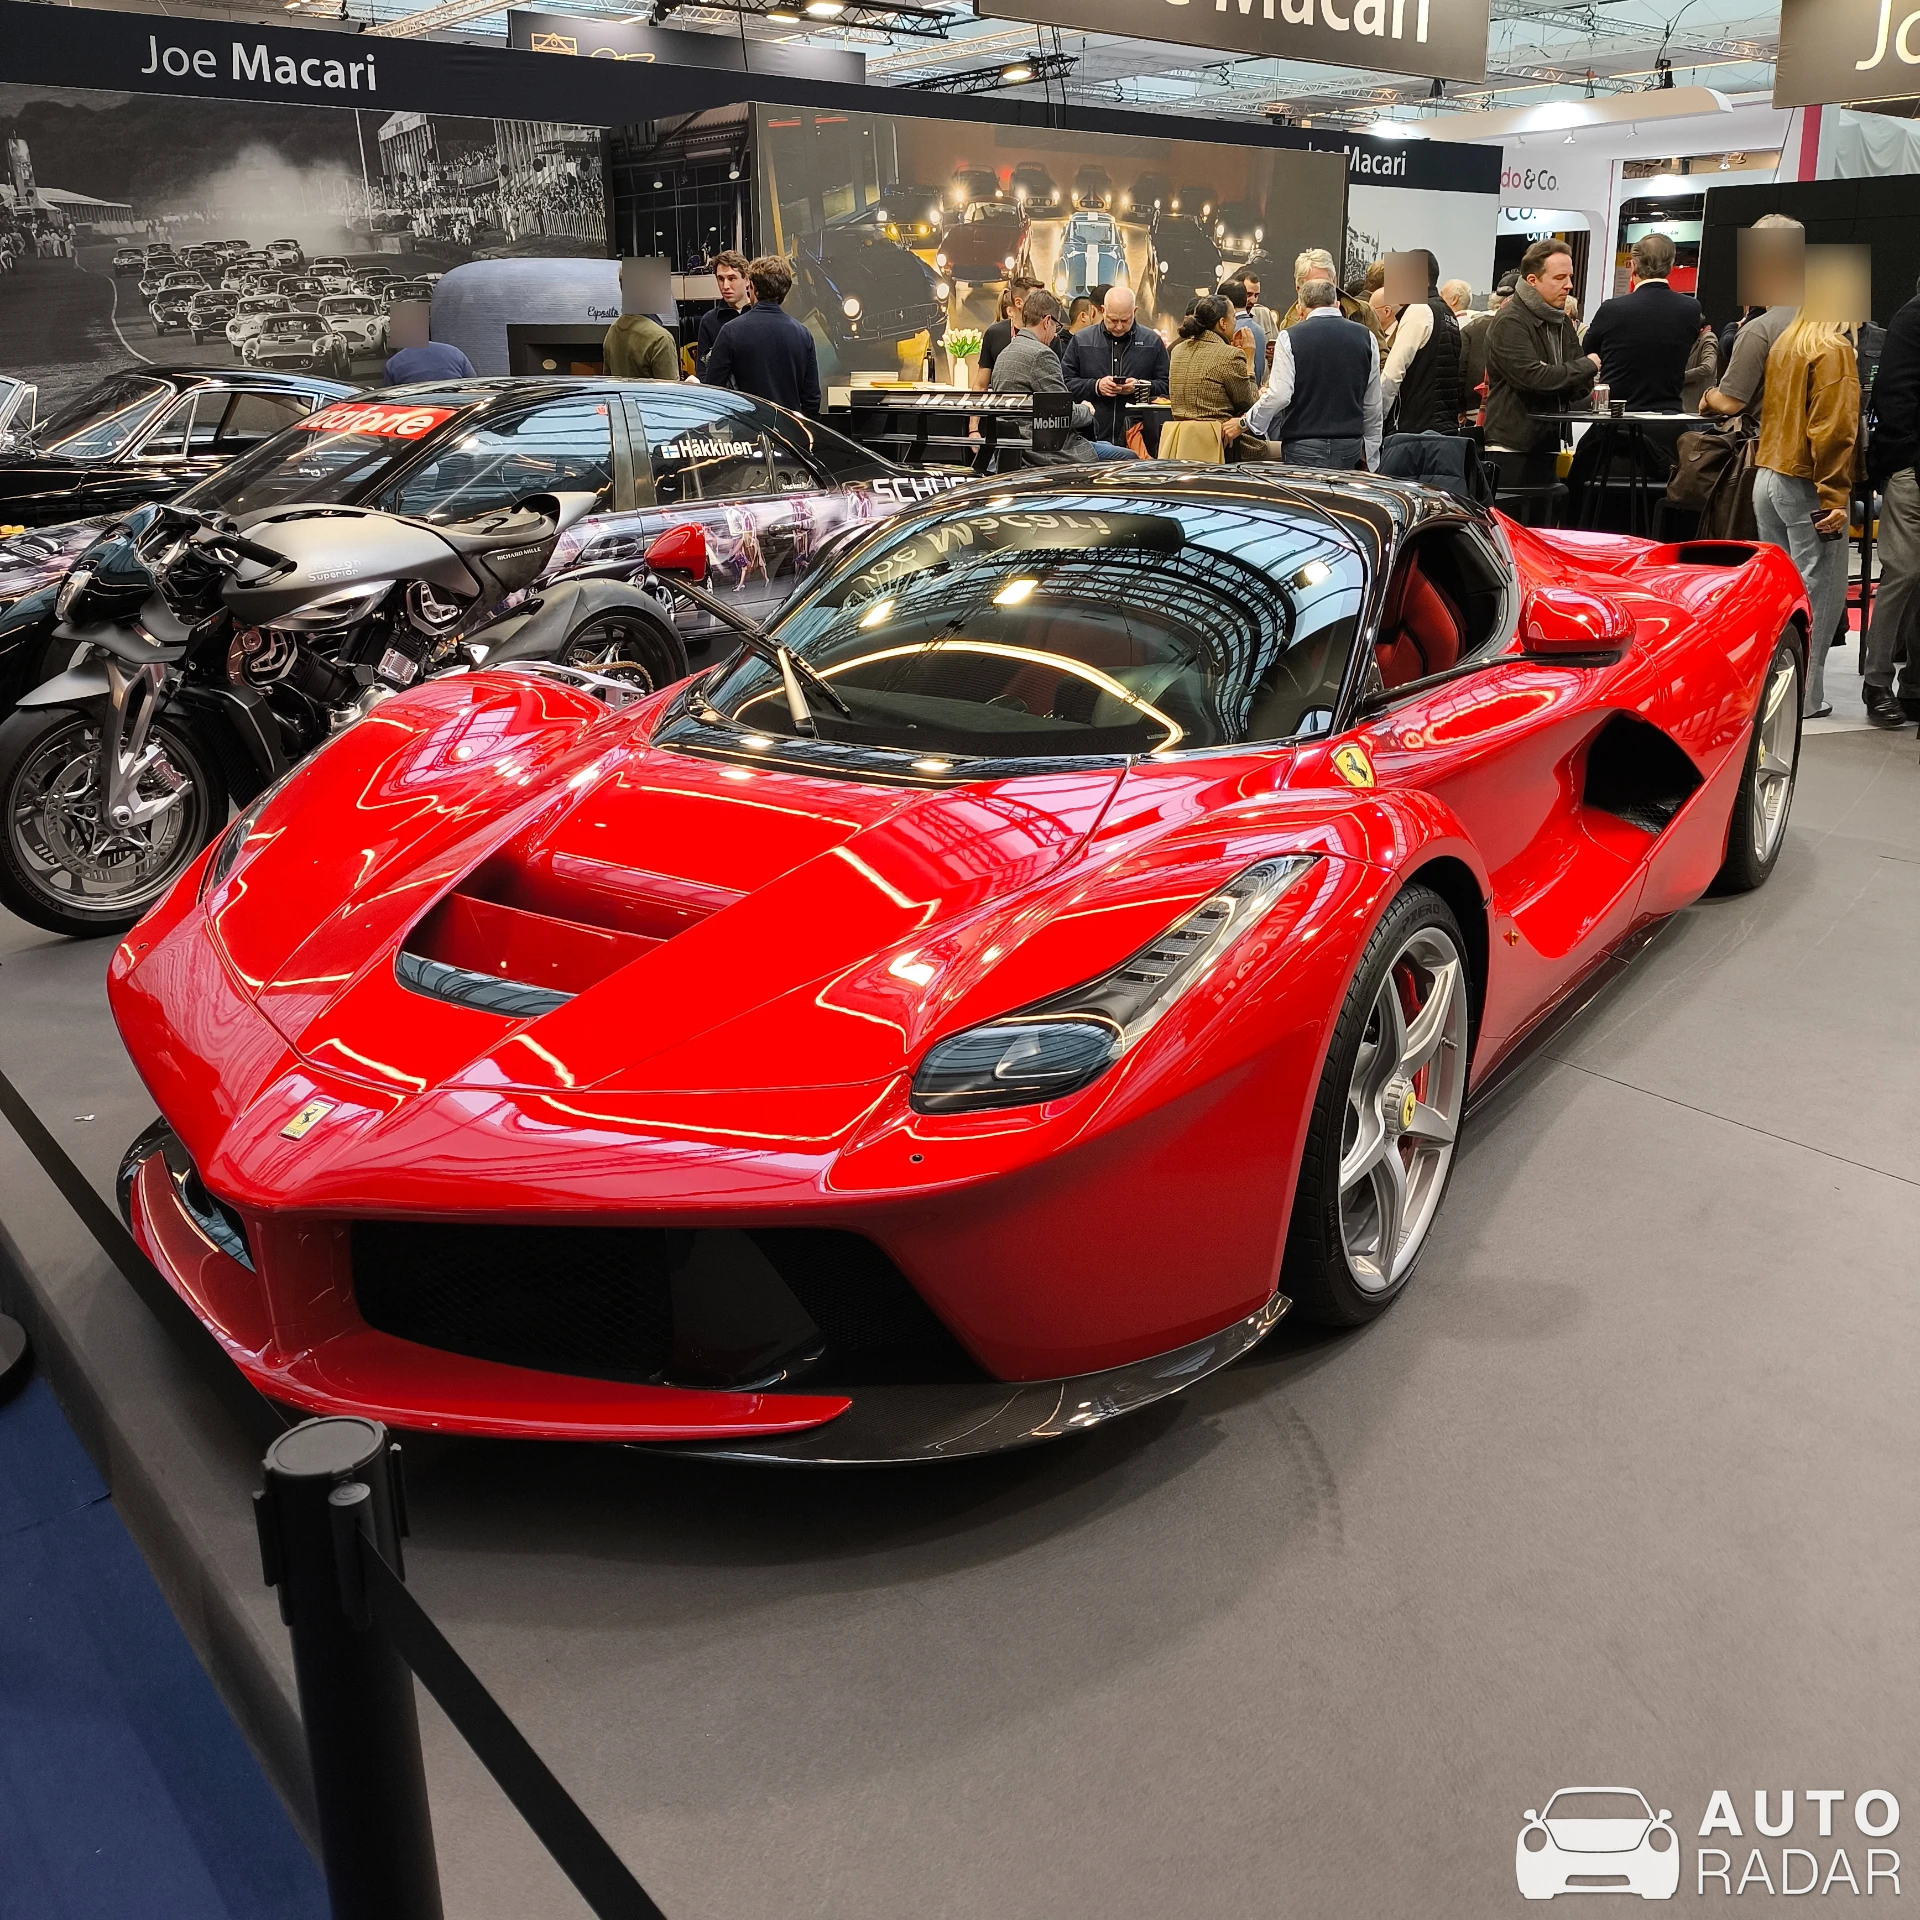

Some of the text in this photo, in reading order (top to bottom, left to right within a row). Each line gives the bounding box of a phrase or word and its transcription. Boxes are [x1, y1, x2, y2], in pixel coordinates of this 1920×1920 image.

[141, 34, 377, 91] Joe Macari
[1343, 145, 1406, 176] Macari
[1524, 168, 1536, 191] &
[1538, 169, 1559, 191] Co.
[1033, 416, 1060, 429] Mobil
[678, 439, 753, 459] Häkkinen
[496, 546, 542, 561] RICHARD MILLE
[307, 568, 359, 582] Superior
